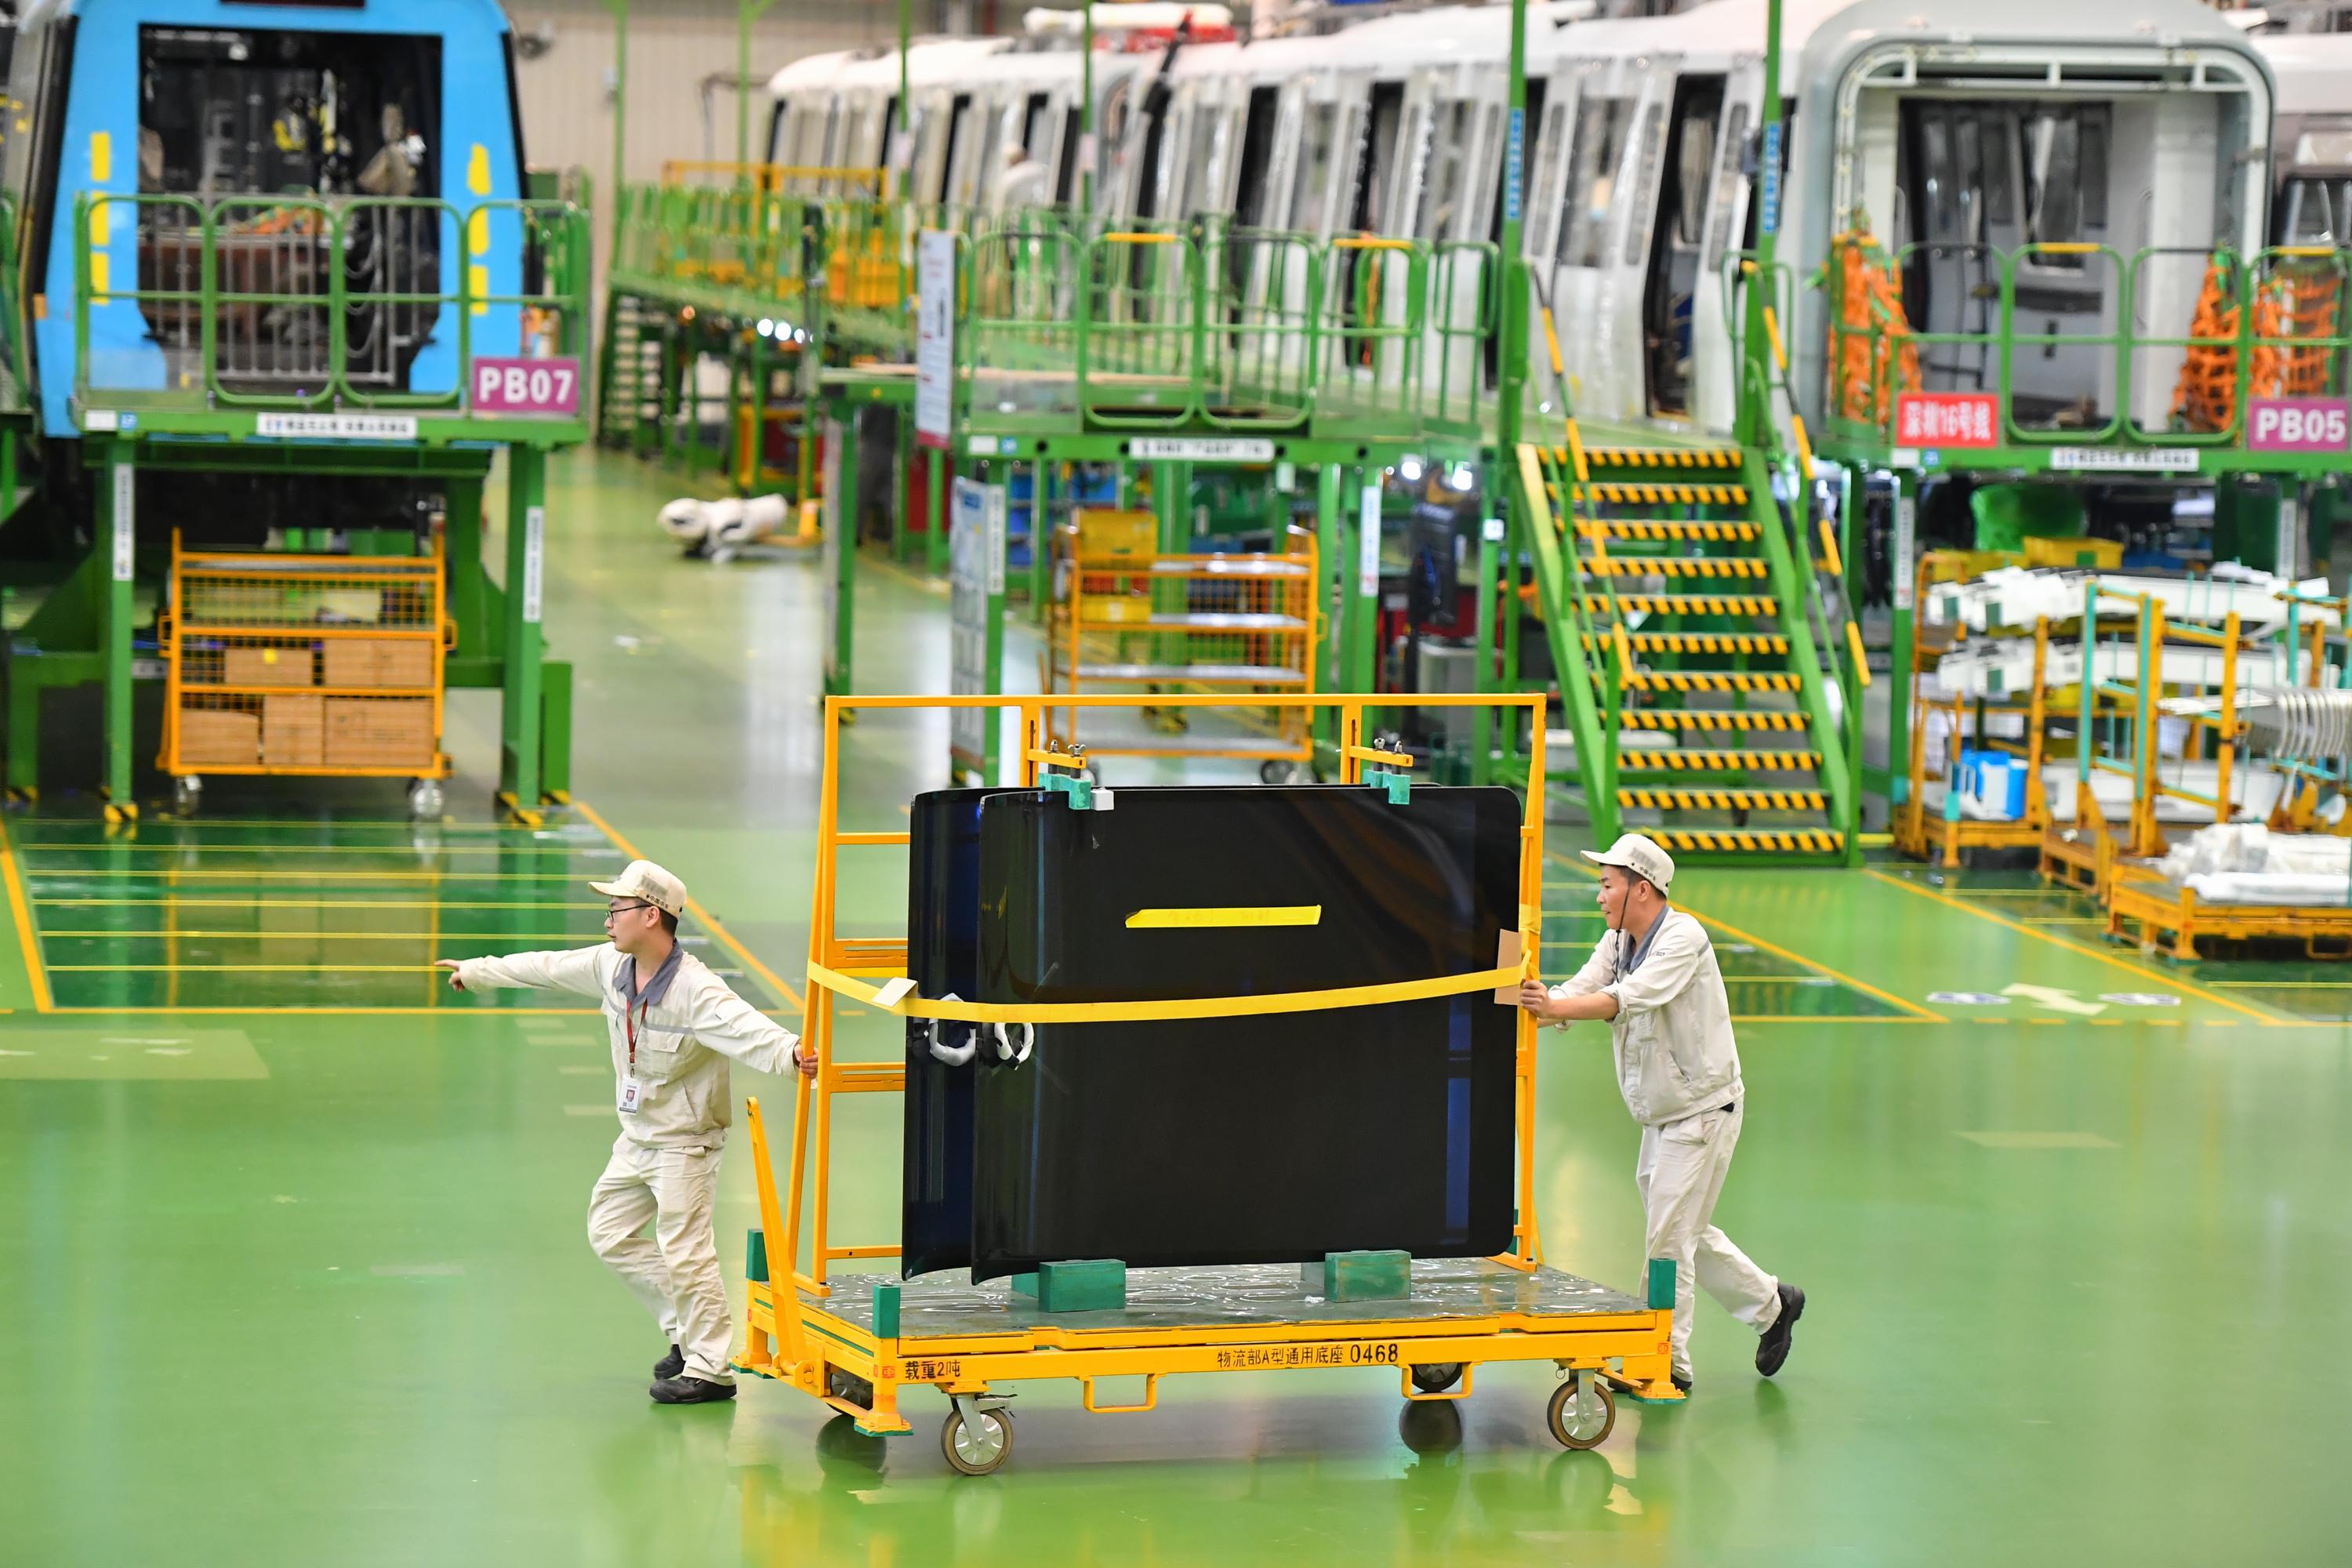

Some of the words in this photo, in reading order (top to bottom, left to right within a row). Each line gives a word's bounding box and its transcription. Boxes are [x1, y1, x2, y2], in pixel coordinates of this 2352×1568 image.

[479, 366, 573, 405] PB07
[2256, 407, 2347, 443] PB05
[905, 1359, 961, 1381] 载重2吨
[1217, 1345, 1344, 1368] 物流部A型通用底座
[1350, 1343, 1399, 1363] 0468
